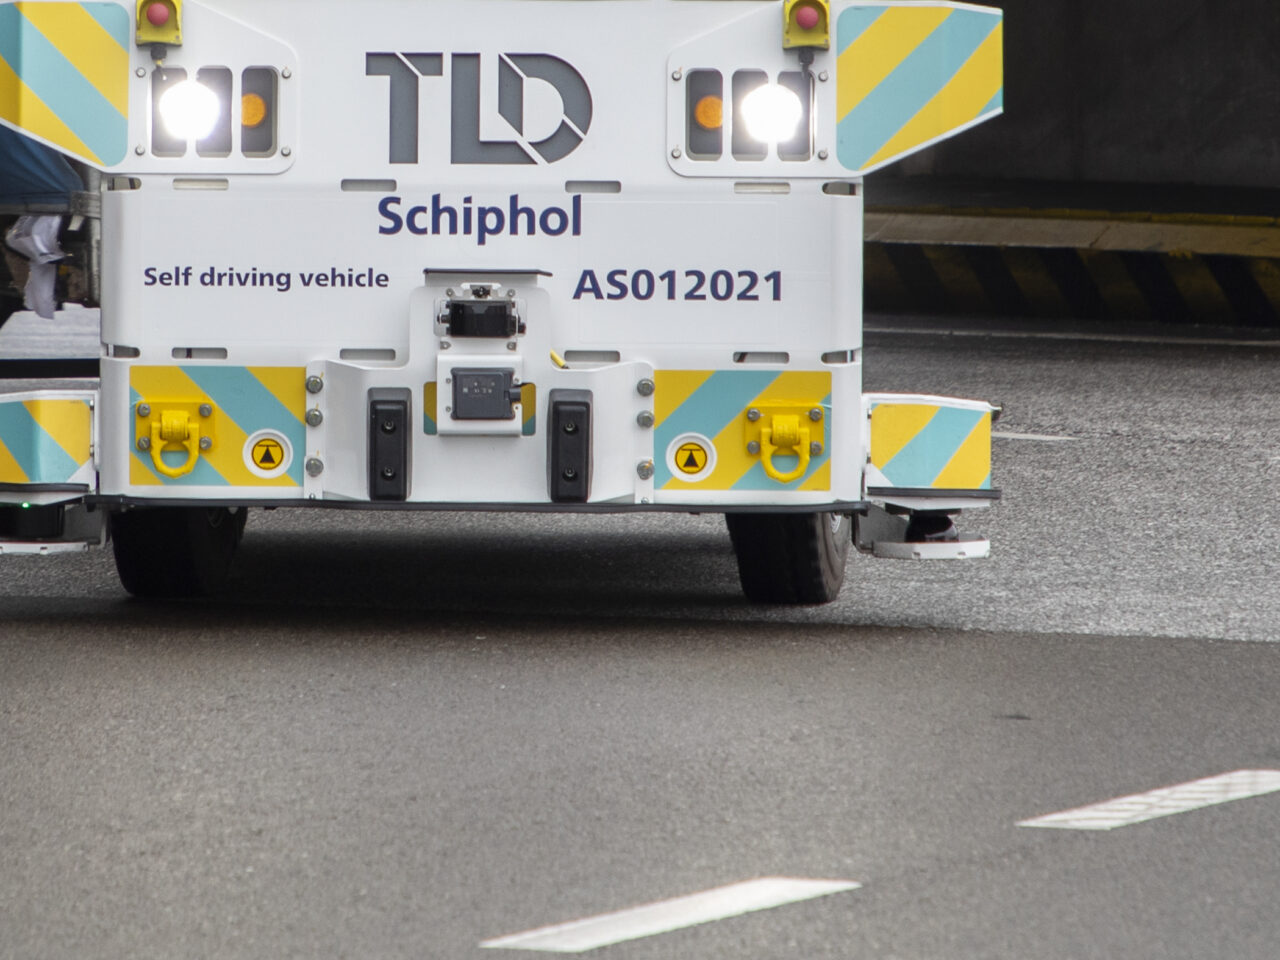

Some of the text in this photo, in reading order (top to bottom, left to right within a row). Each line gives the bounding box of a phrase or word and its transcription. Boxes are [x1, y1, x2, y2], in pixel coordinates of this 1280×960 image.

[365, 52, 593, 165] TLD
[378, 193, 582, 246] Schiphol
[143, 266, 390, 293] Self driving vehicle
[572, 269, 782, 302] AS012021
